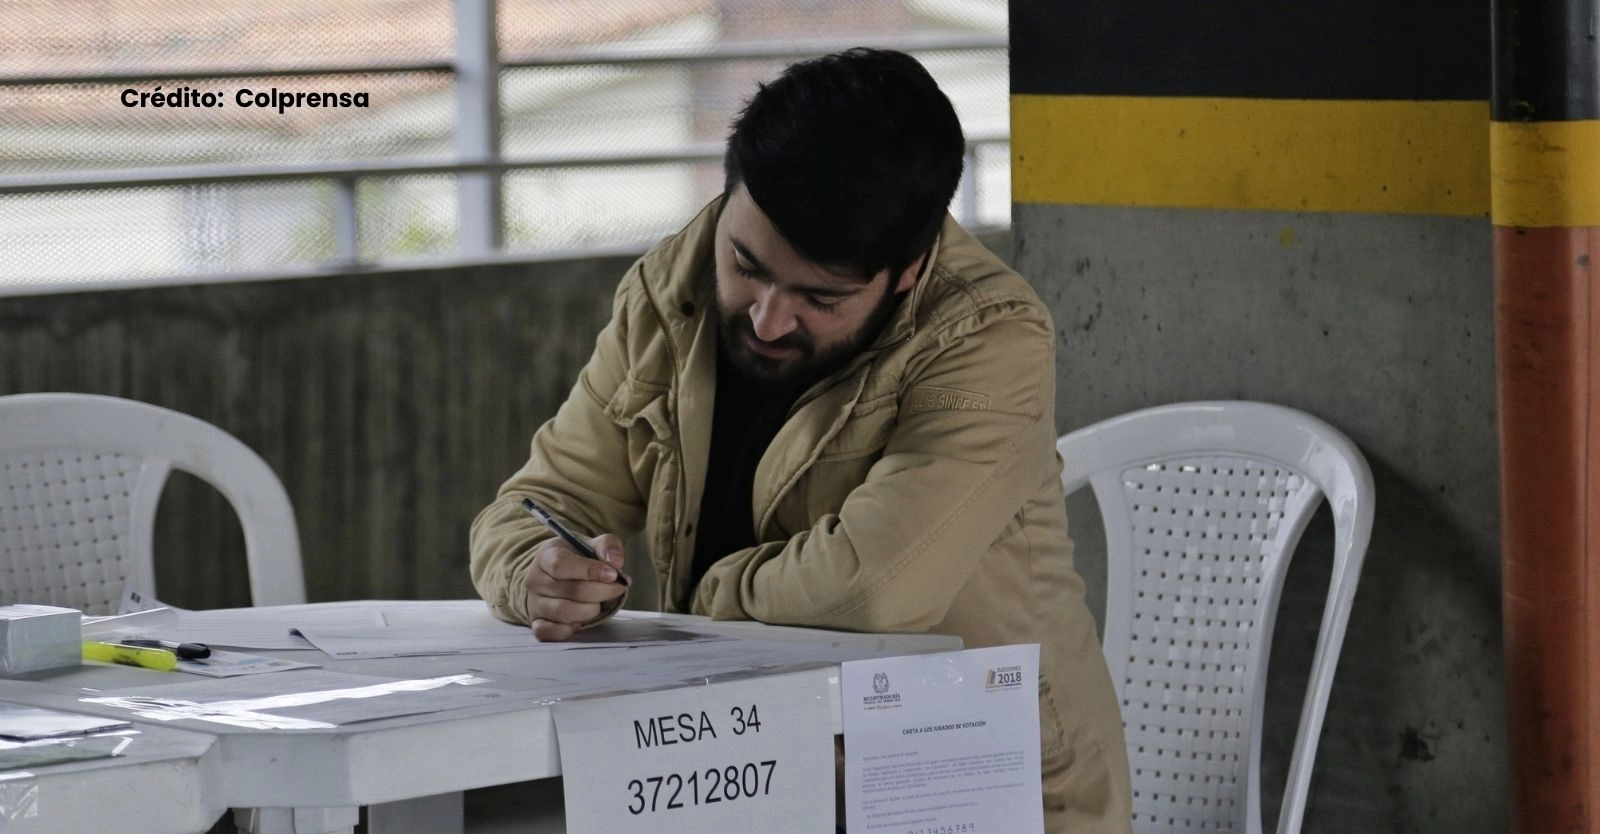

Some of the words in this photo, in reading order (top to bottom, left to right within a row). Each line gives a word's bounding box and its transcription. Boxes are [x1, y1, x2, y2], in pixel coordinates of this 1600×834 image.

[997, 671, 1022, 684] 2018
[633, 711, 717, 749] MESA
[730, 704, 762, 735] 34
[902, 728, 919, 736] CARTA
[627, 760, 777, 815] 37212807
